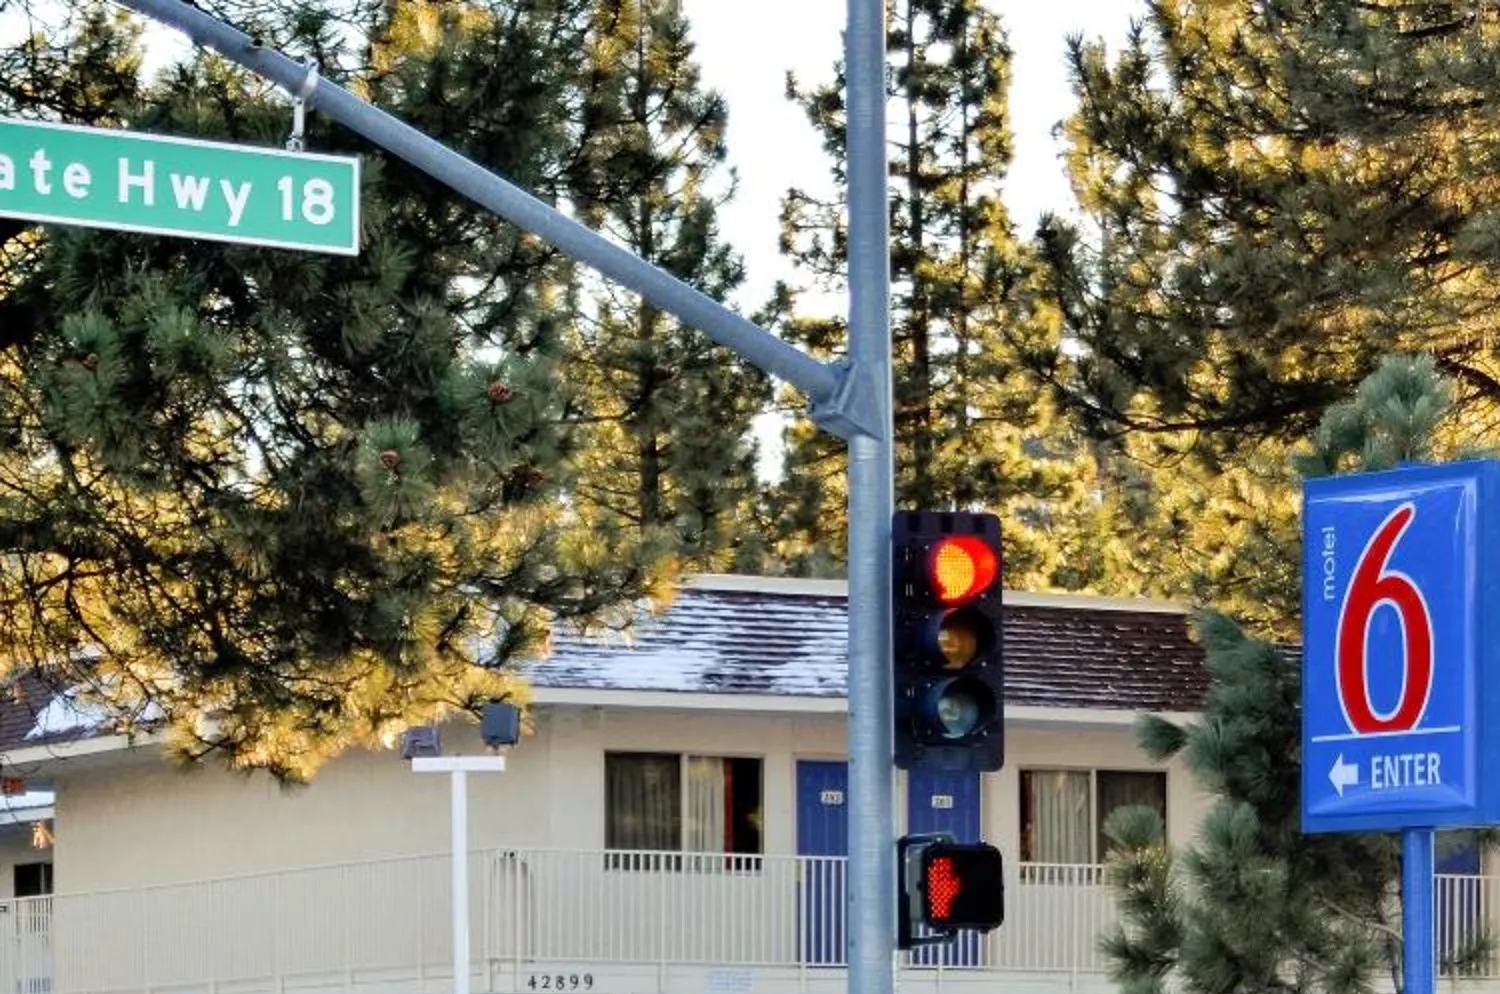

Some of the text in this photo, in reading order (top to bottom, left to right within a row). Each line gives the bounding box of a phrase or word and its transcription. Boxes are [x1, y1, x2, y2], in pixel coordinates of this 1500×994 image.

[118, 157, 252, 227] Hwy
[277, 175, 336, 225] 18
[1321, 525, 1336, 601] motel
[1334, 502, 1435, 736] 6
[1371, 752, 1441, 789] ENTER
[527, 973, 593, 991] 42899
